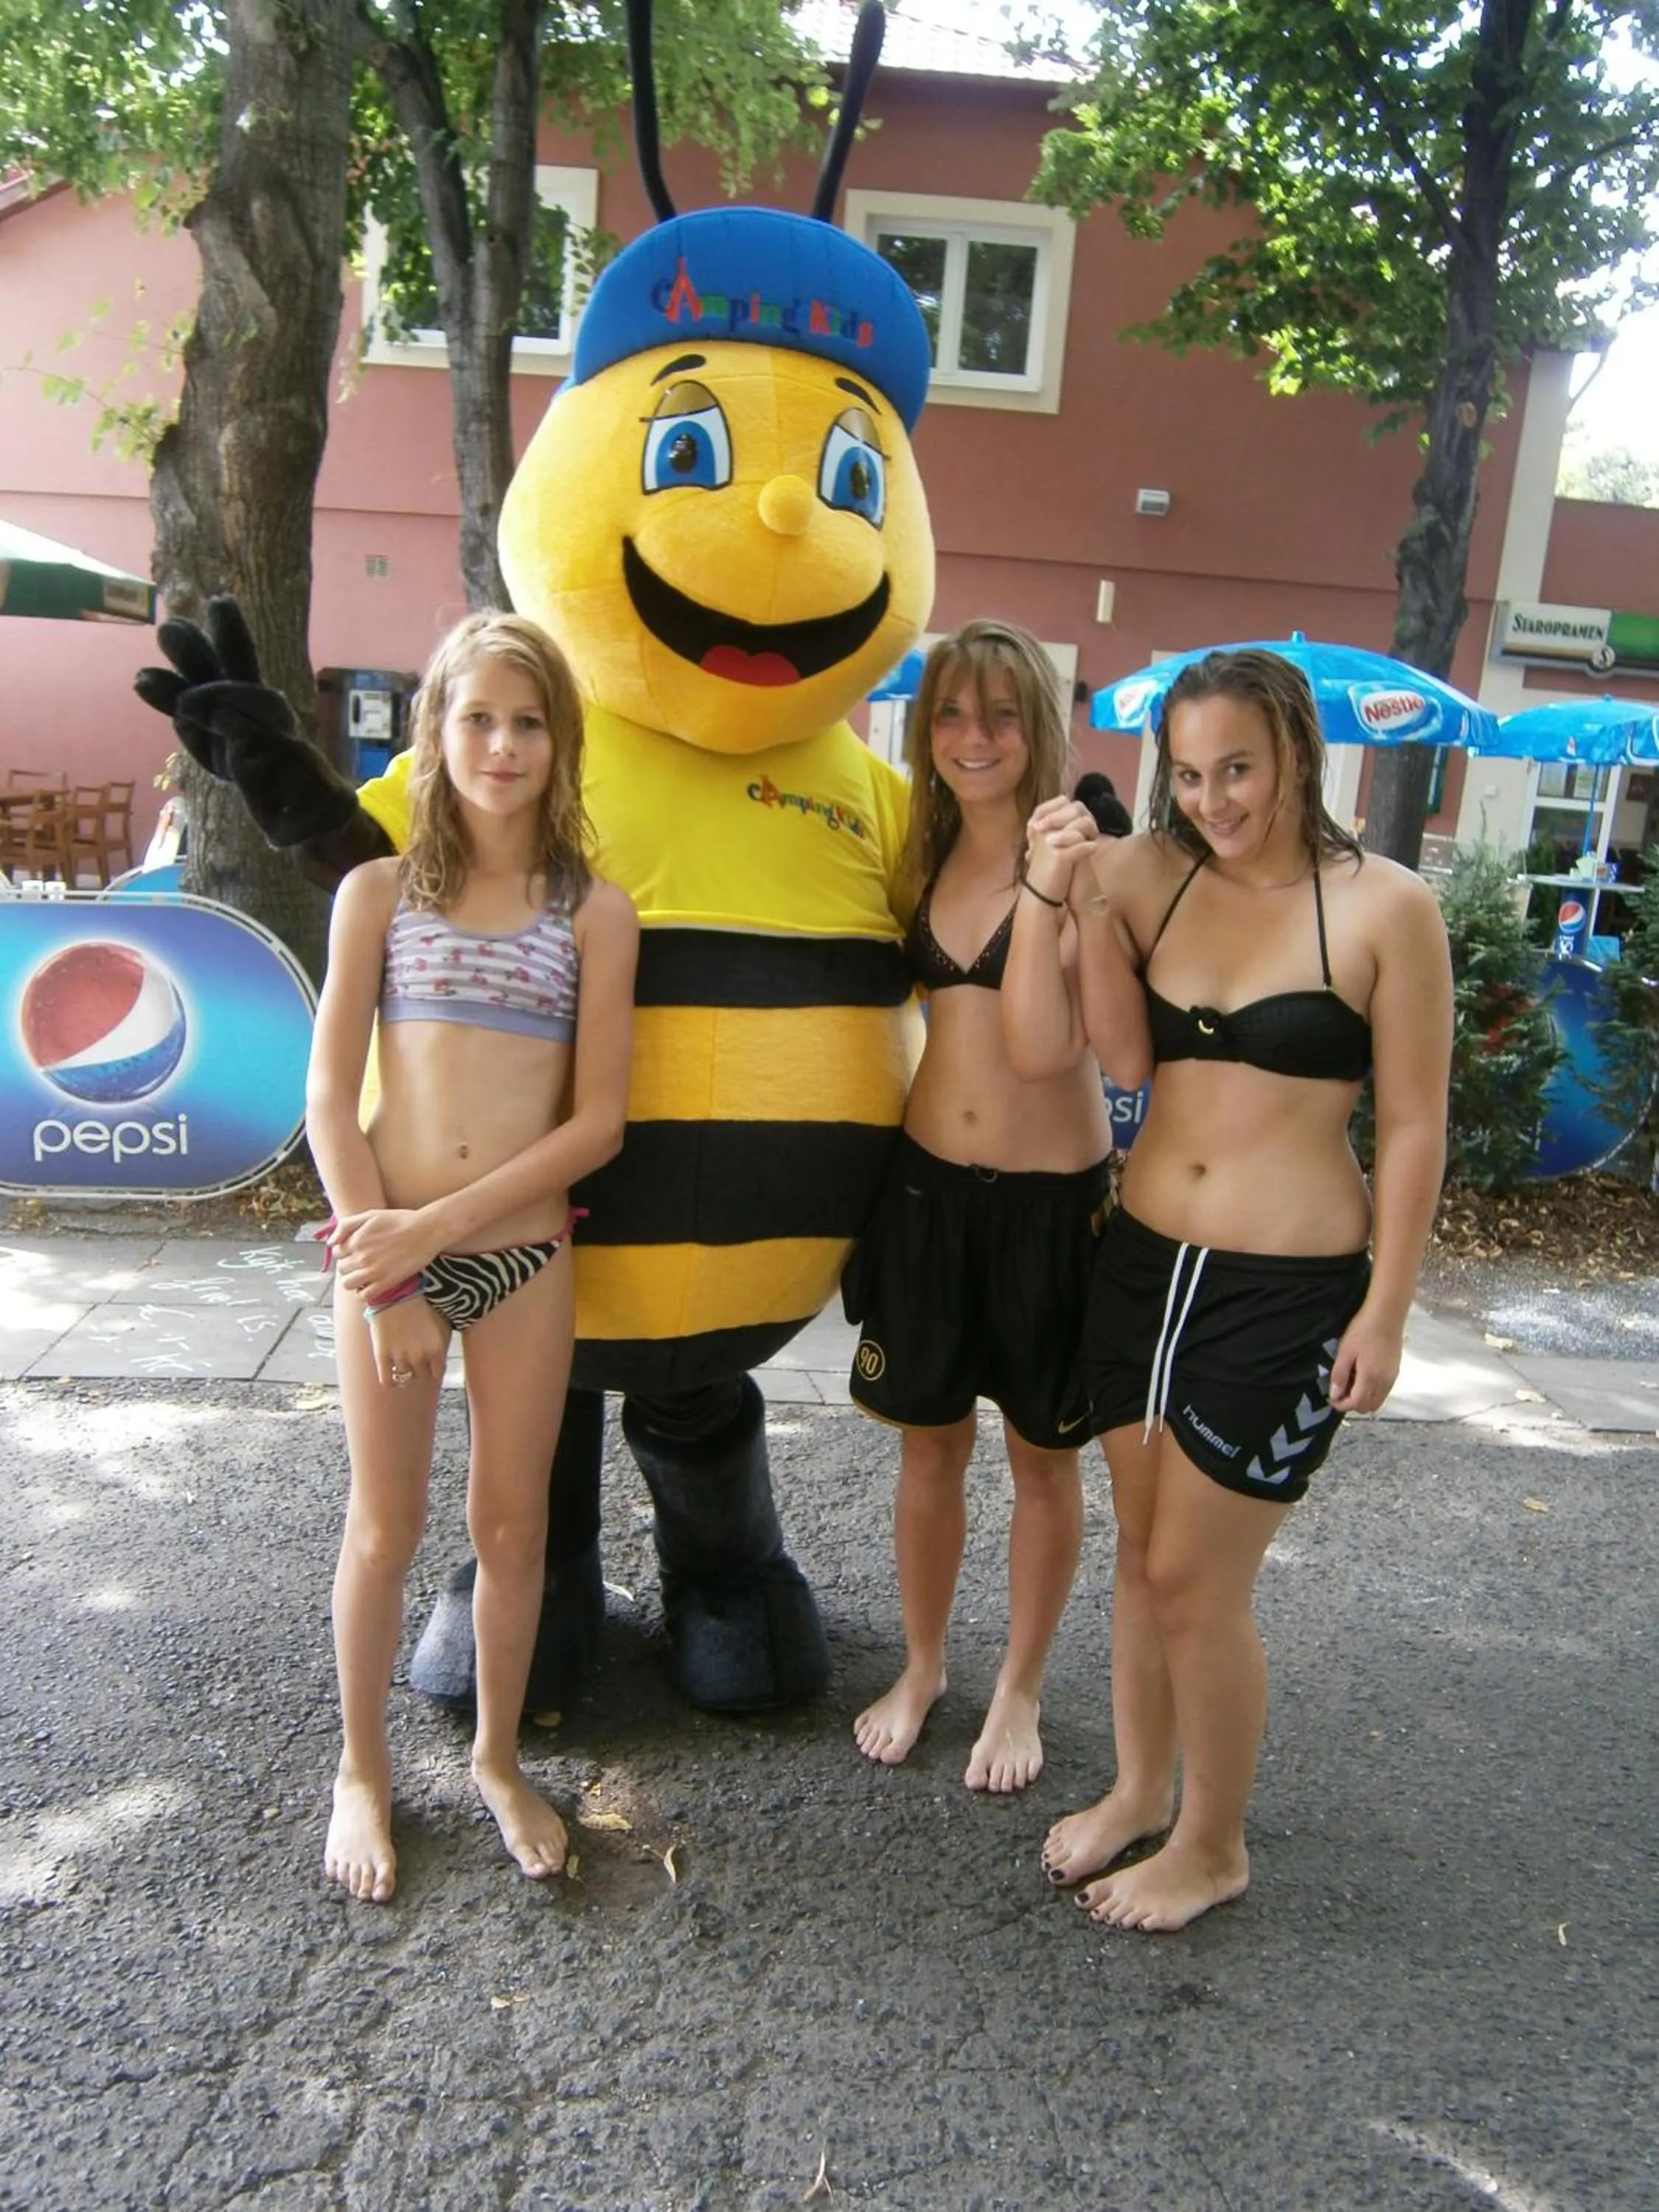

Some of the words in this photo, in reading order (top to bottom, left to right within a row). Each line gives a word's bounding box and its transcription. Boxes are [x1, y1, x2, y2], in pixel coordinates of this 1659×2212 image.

[33, 1113, 188, 1164] pepsi
[860, 1346, 879, 1376] 90
[1182, 1404, 1242, 1459] hummel
